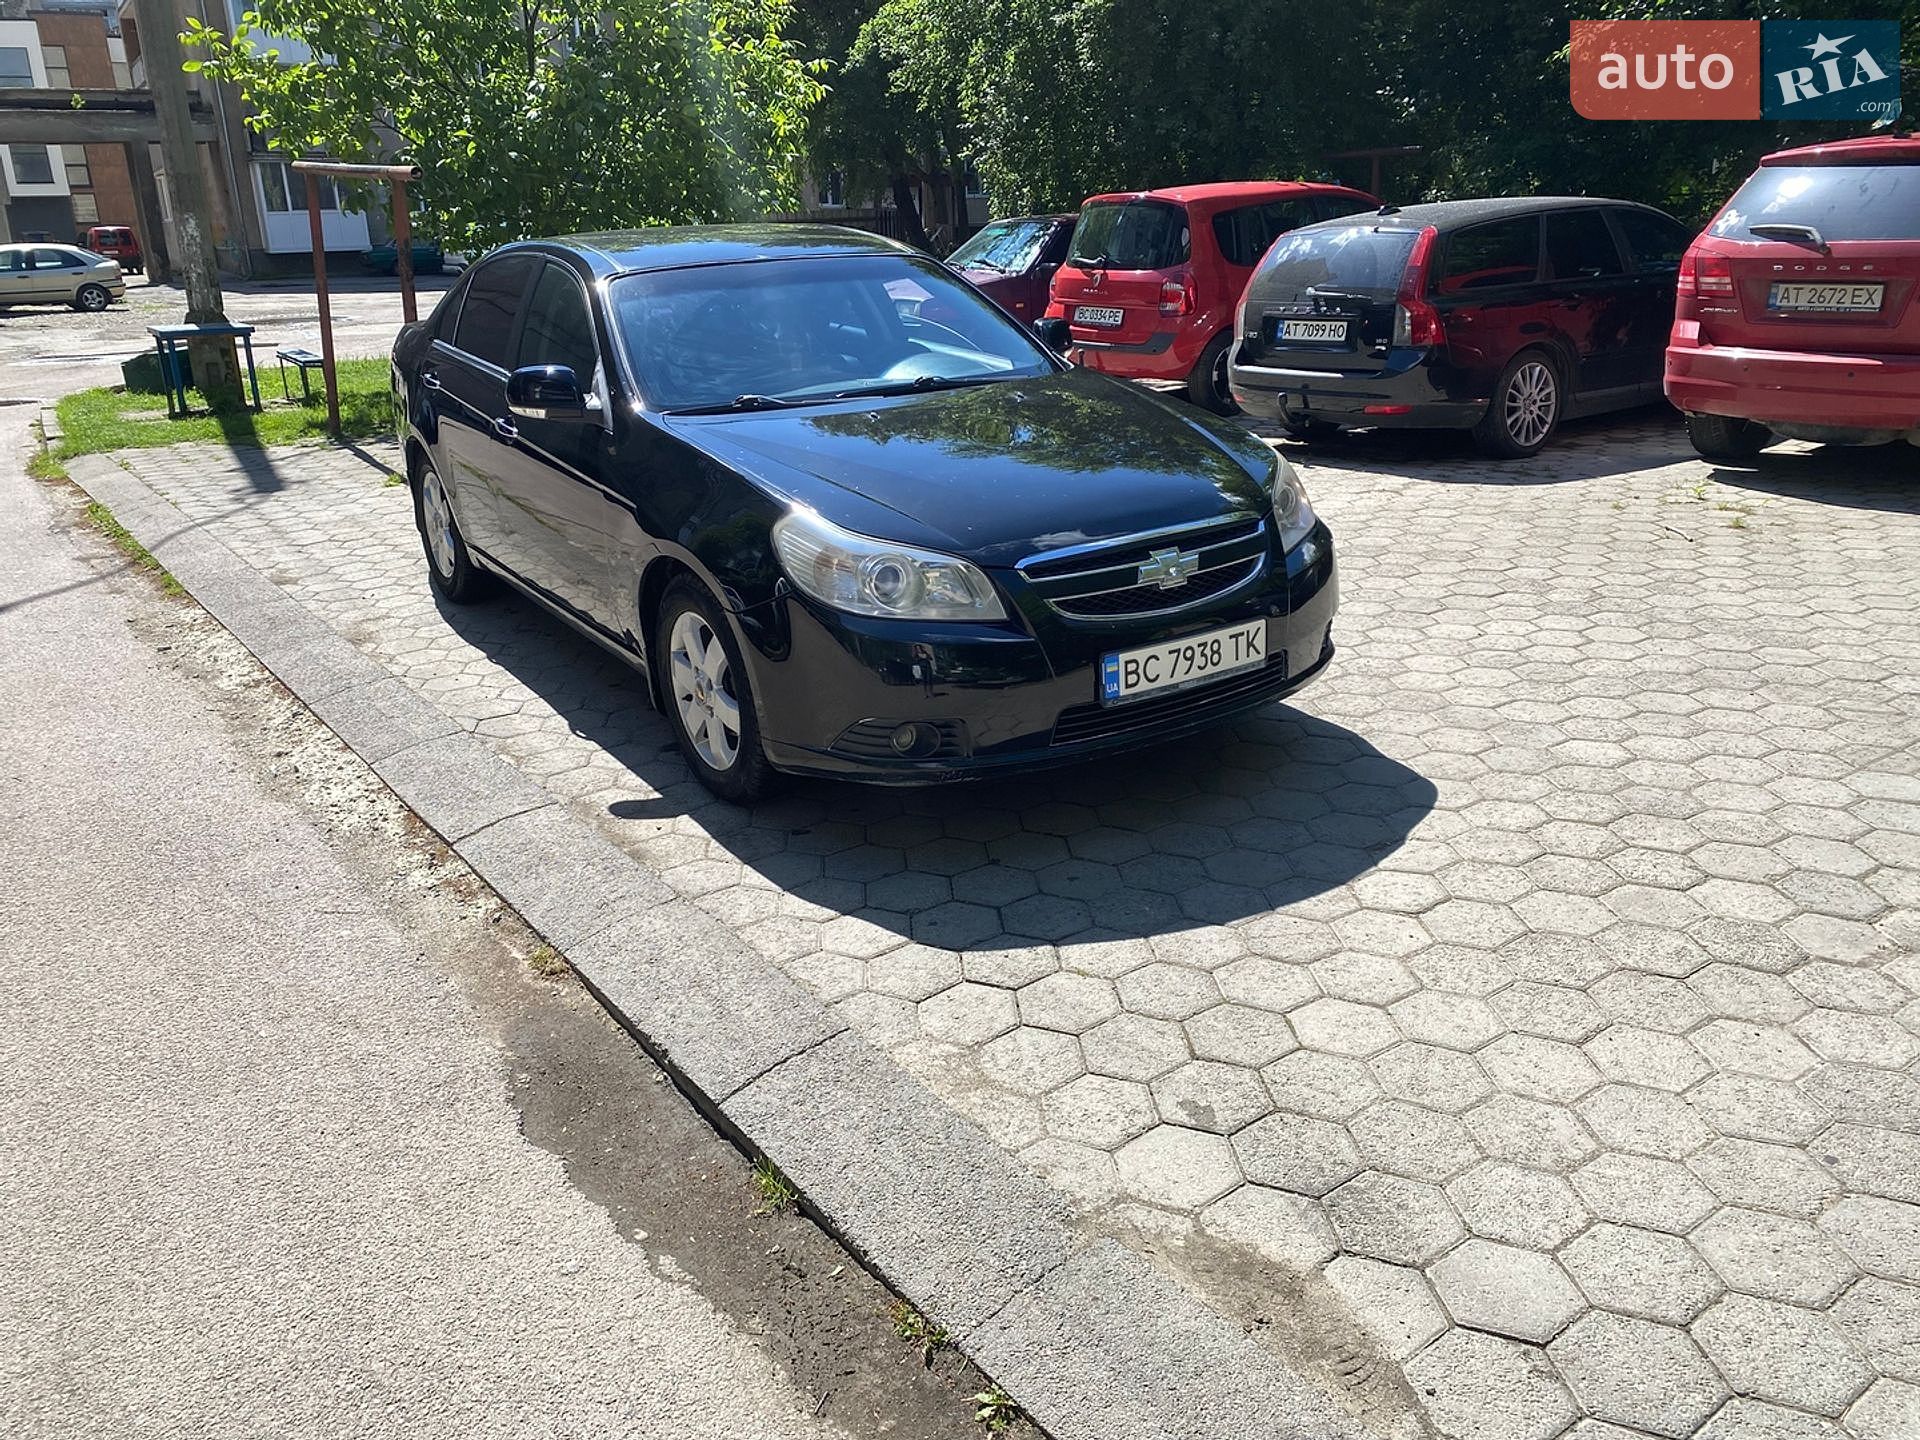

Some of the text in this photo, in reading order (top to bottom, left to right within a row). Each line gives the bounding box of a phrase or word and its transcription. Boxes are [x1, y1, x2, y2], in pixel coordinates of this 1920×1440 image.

[1780, 287, 1879, 305] AT 2672 EX
[1108, 310, 1120, 322] PE
[1284, 323, 1345, 339] AT 7099 HO
[1124, 626, 1262, 690] BC 7938 TK
[1106, 683, 1119, 693] UA
